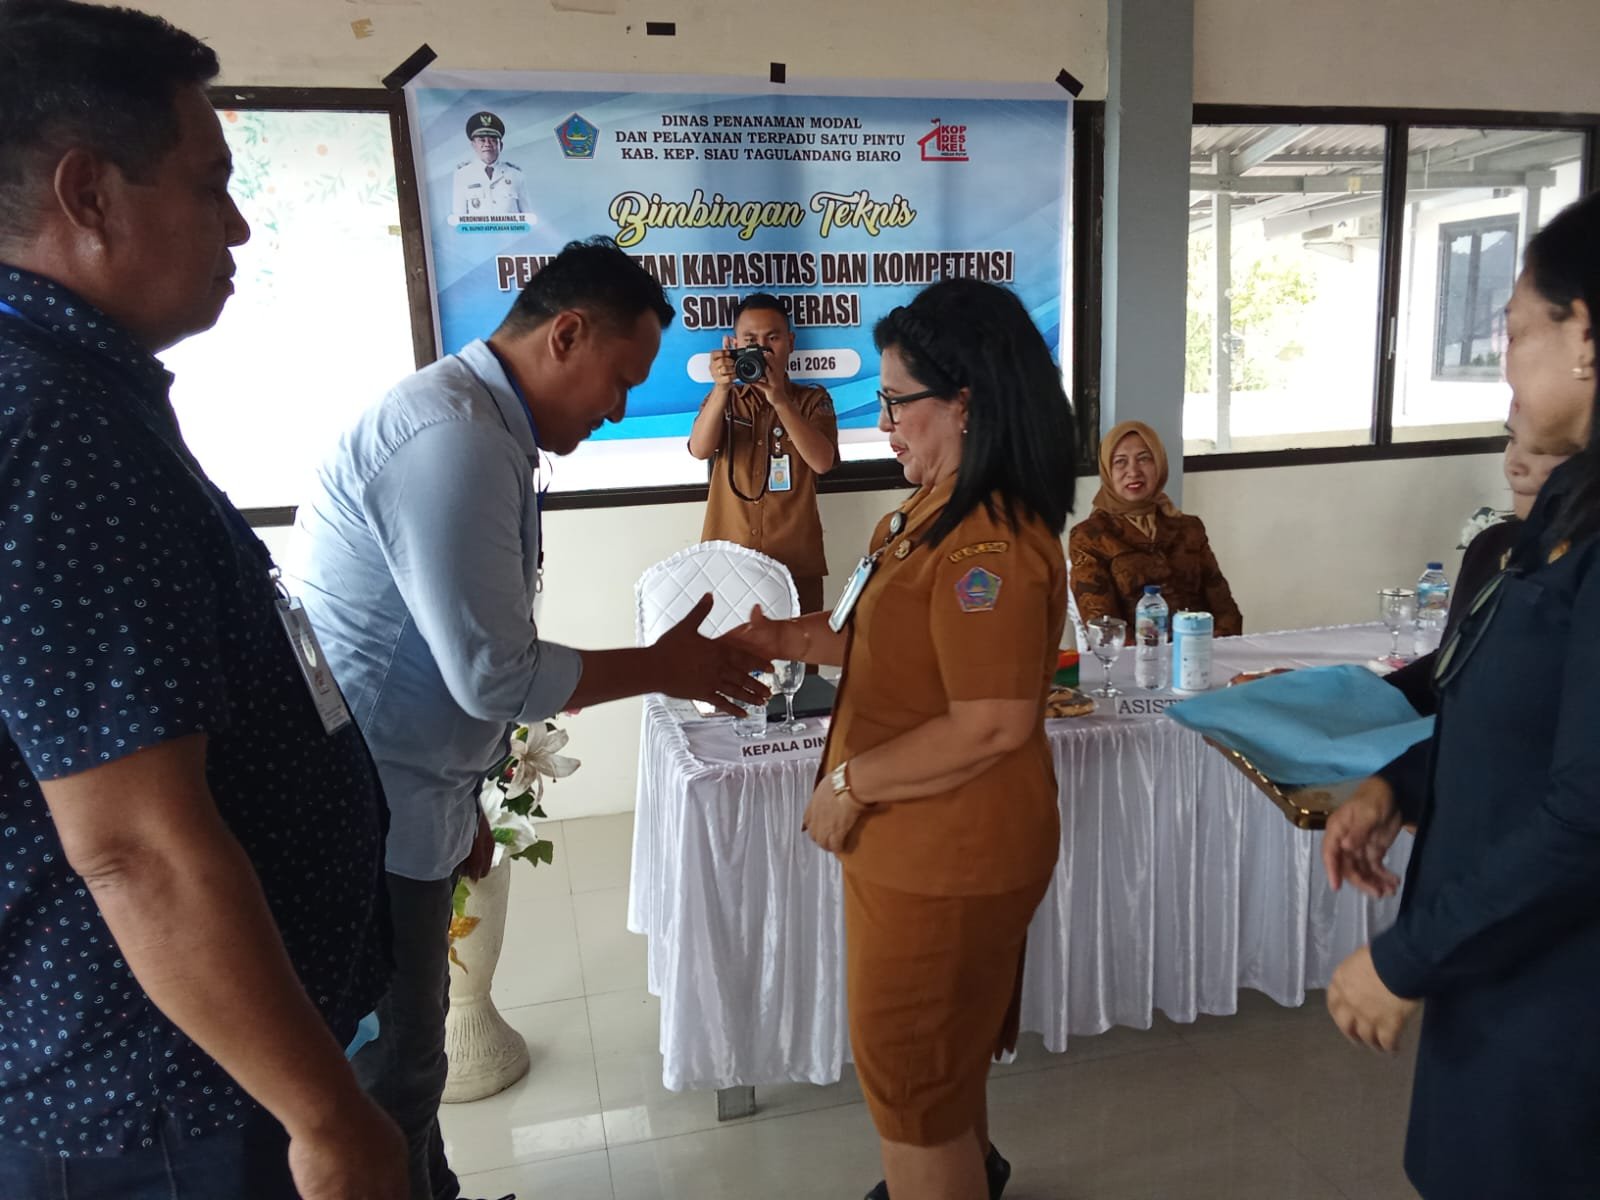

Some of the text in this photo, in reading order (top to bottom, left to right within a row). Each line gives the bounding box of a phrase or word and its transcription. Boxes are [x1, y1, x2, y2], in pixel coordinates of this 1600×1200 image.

[662, 115, 862, 129] DINAS PENANAMAN MODAL
[941, 125, 967, 134] KOP
[615, 131, 905, 146] DAN PELAYANAN TERPADU SATU PINTU
[941, 134, 966, 143] DES
[621, 148, 901, 161] KAB. KEP. SIAU TAGULANDANG BIARO
[941, 143, 967, 152] KEL
[609, 189, 916, 247] Bimbingan Teknis
[682, 253, 817, 287] KAPASITAS
[821, 253, 867, 285] DAN
[873, 251, 1015, 284] KOMPETENSI
[683, 295, 738, 328] SDM
[786, 357, 836, 372] ei 2026
[742, 736, 827, 757] KEPALA DIN
